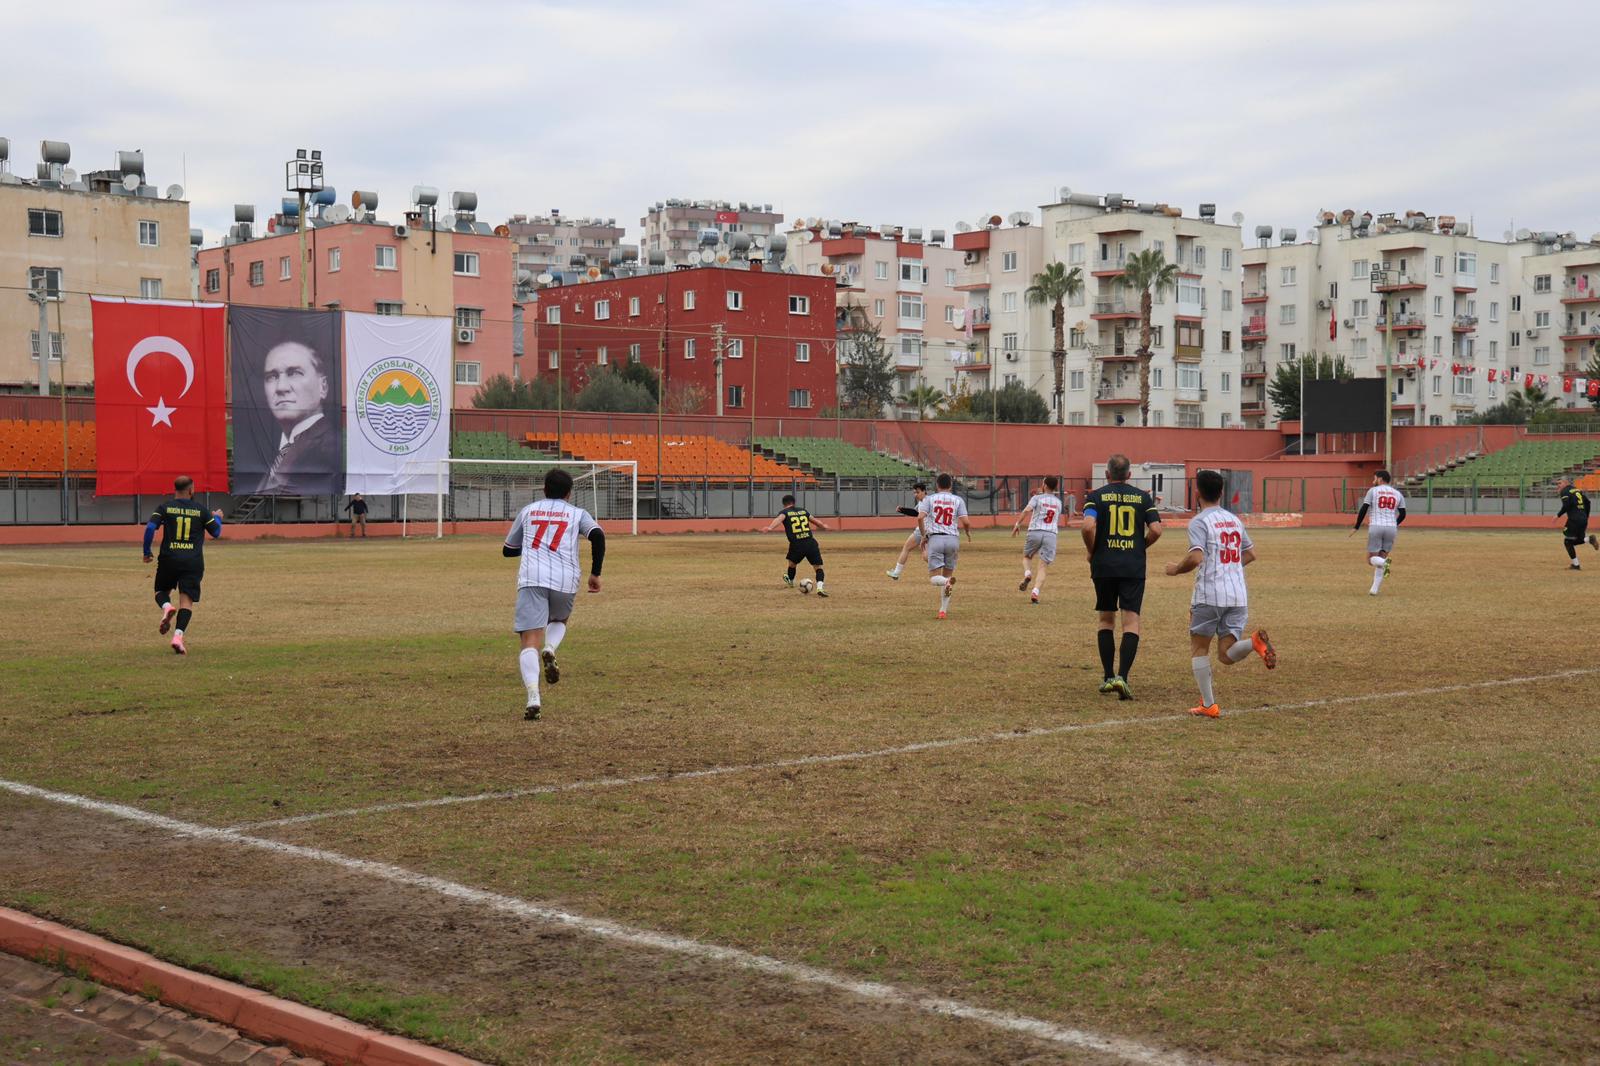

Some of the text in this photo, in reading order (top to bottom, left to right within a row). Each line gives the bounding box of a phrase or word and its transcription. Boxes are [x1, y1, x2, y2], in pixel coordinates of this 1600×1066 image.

[367, 360, 414, 379] TOROSLAR
[790, 515, 810, 533] 22
[933, 506, 954, 526] 26
[1109, 504, 1135, 536] 10
[176, 516, 191, 540] 11
[531, 519, 569, 552] 77
[1107, 539, 1134, 551] YALÇIN
[1219, 530, 1242, 564] 33
